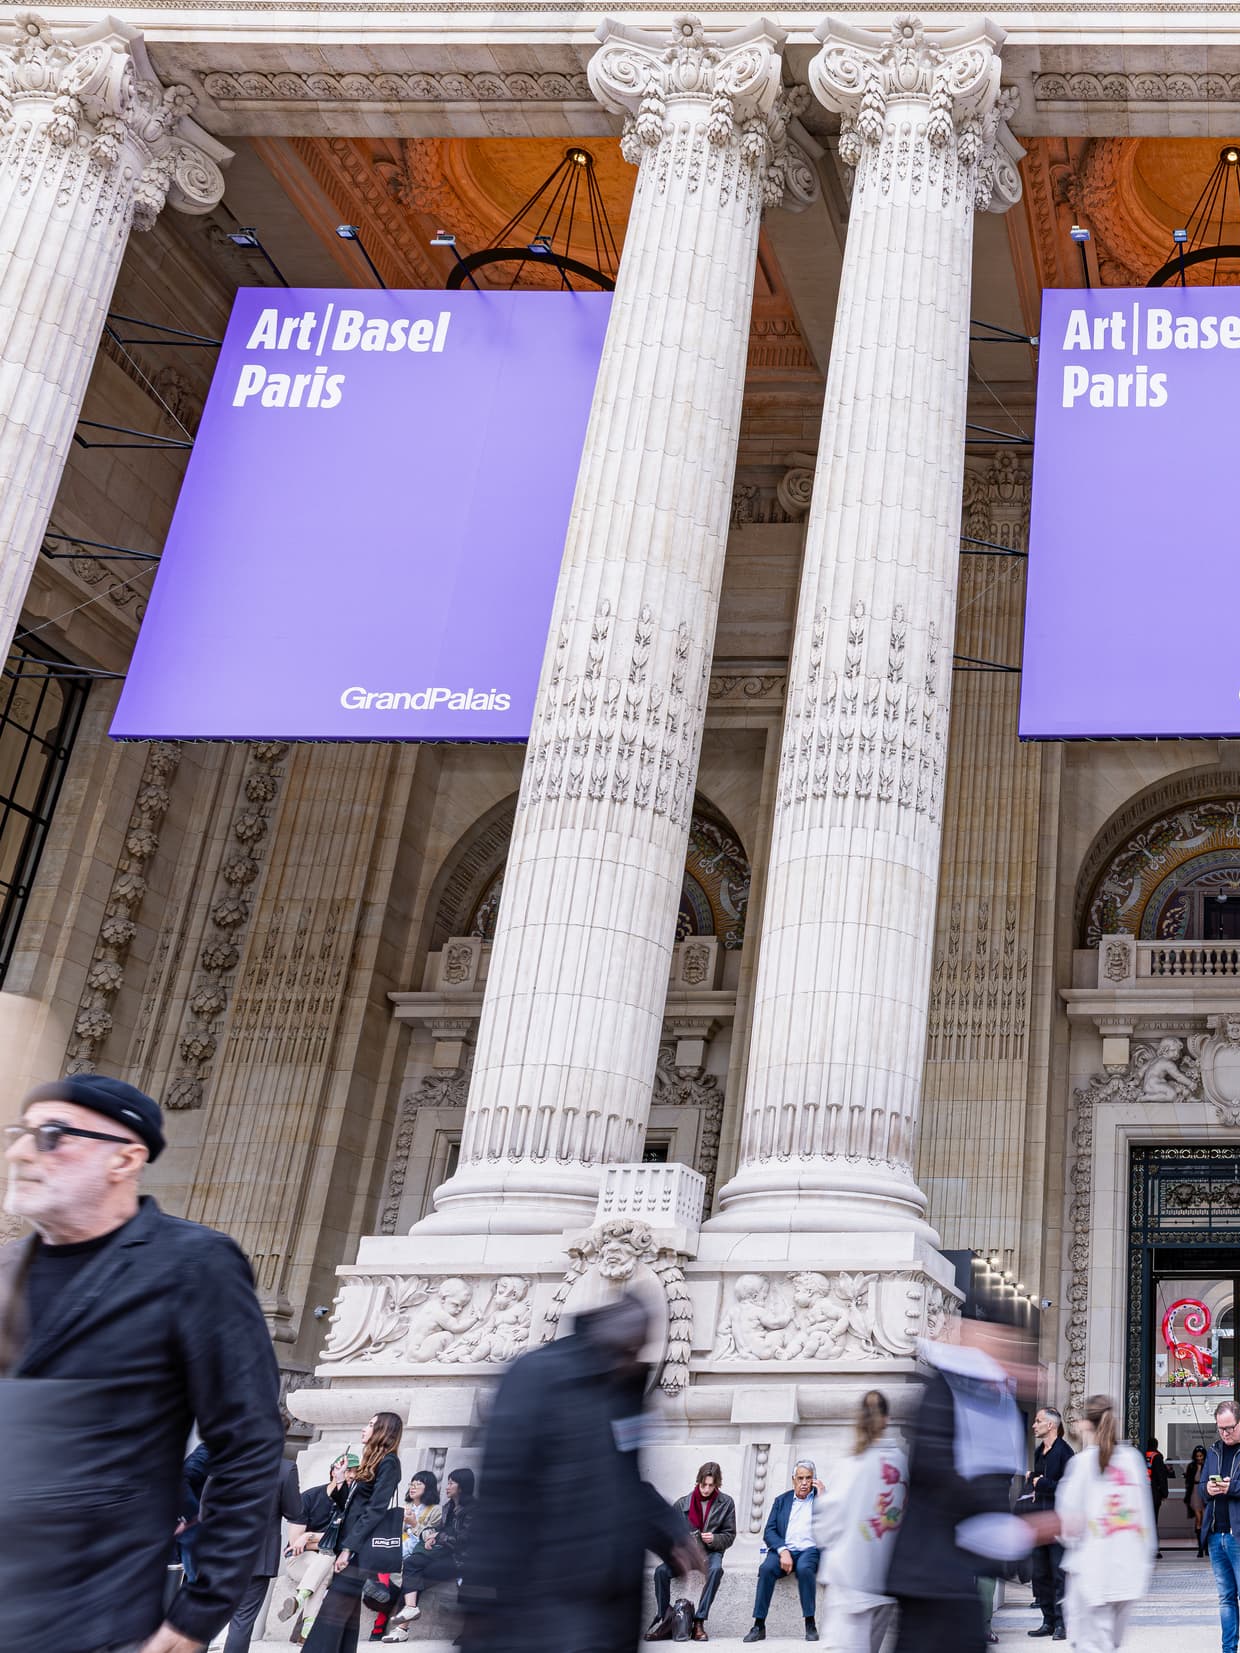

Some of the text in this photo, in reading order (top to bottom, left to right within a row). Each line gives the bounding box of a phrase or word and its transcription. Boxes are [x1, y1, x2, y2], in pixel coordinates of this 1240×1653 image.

[232, 364, 346, 409] Paris
[1062, 365, 1169, 408] Paris
[340, 686, 511, 711] GrandPalais
